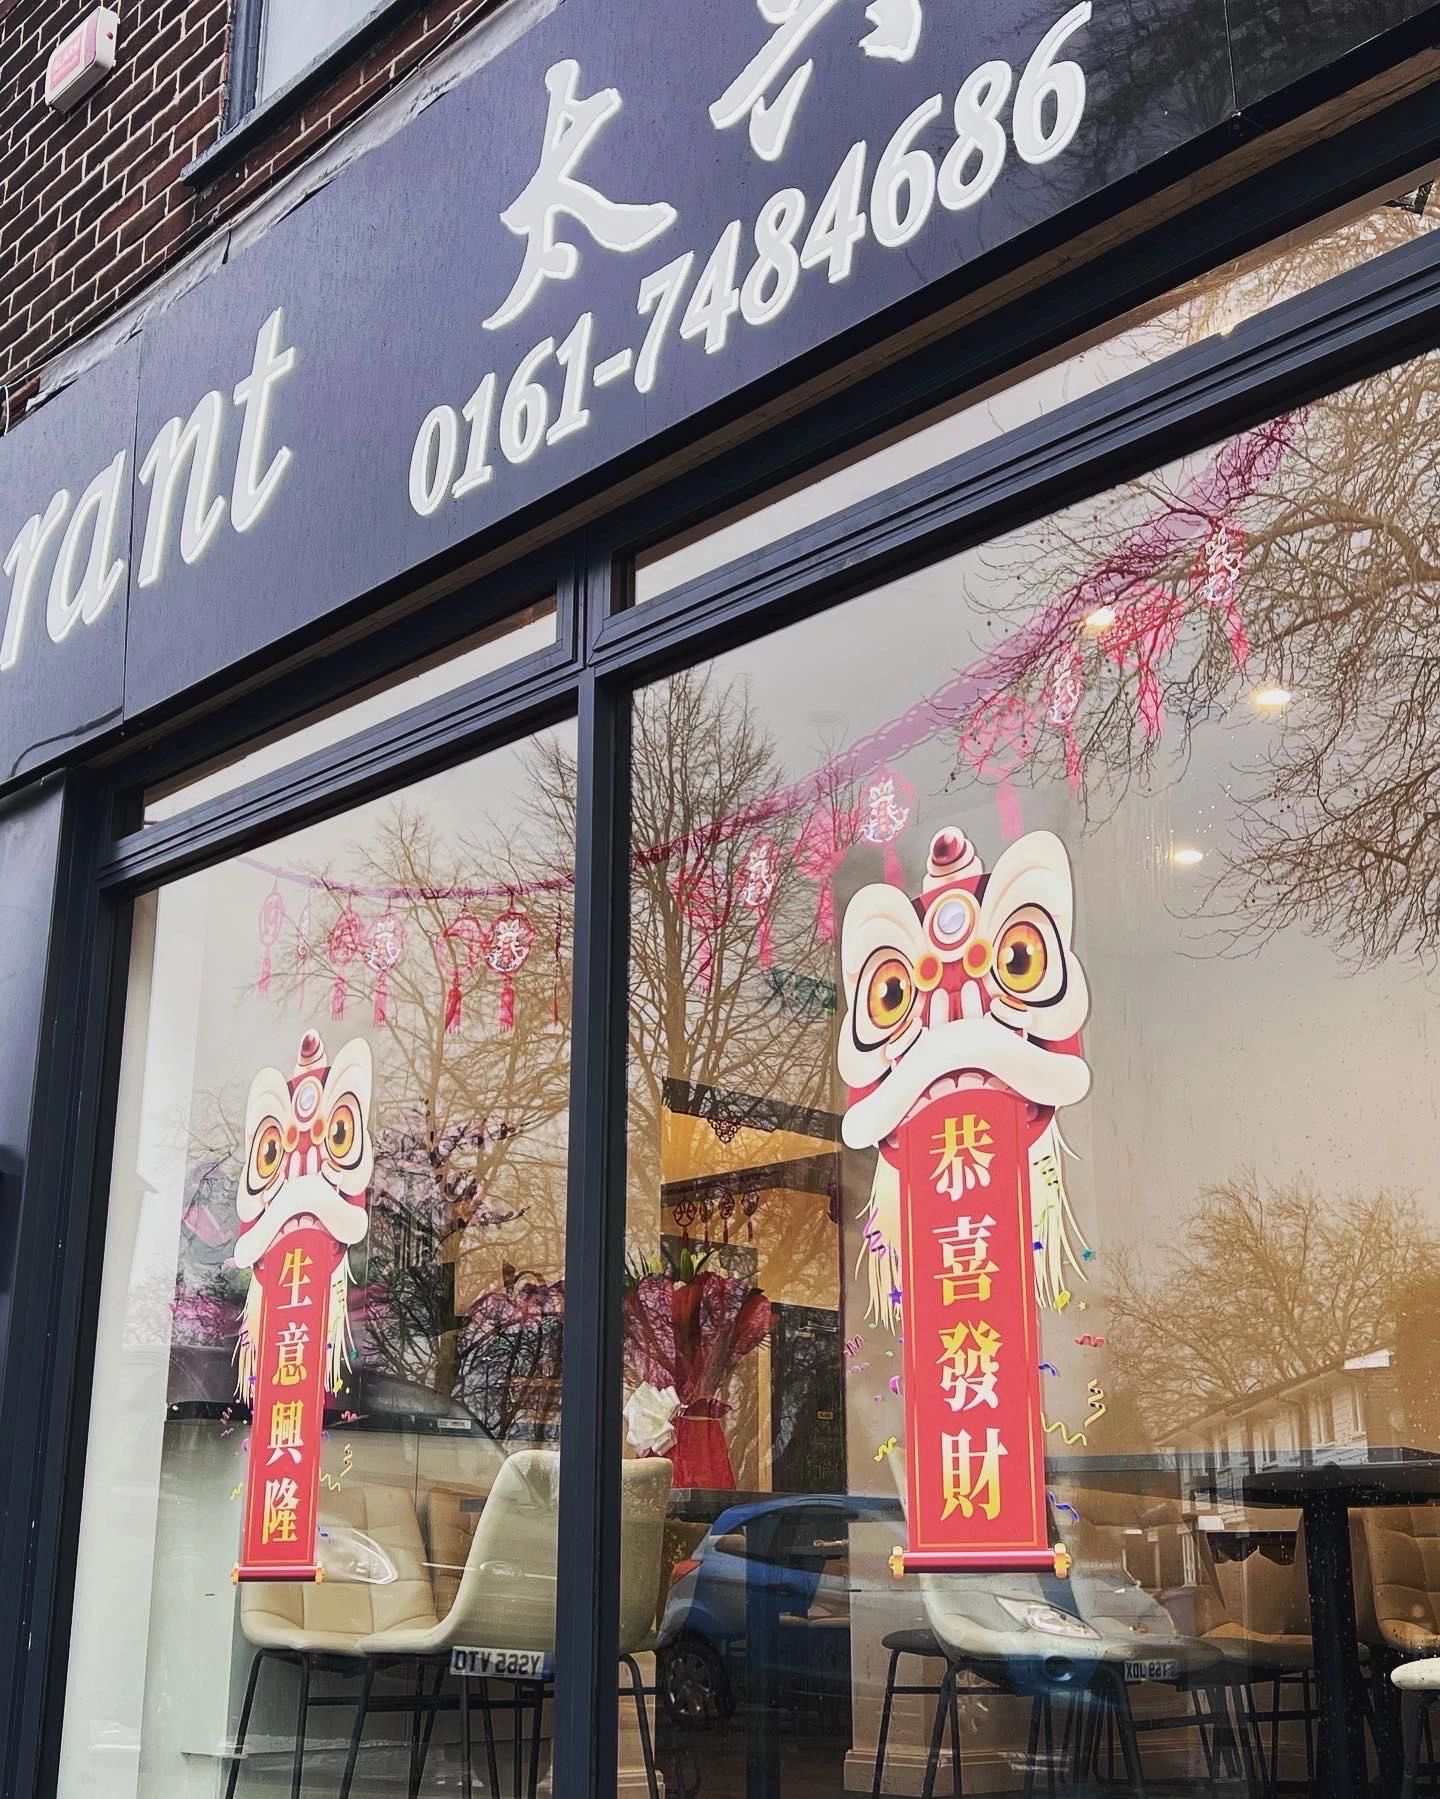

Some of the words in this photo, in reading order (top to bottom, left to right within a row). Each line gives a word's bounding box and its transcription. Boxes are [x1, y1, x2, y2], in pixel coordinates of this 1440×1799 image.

[408, 0, 1092, 516] 0161-7484686
[0, 306, 297, 671] rant
[261, 1248, 313, 1545] 生意興隆
[928, 1114, 1009, 1521] 恭喜發財
